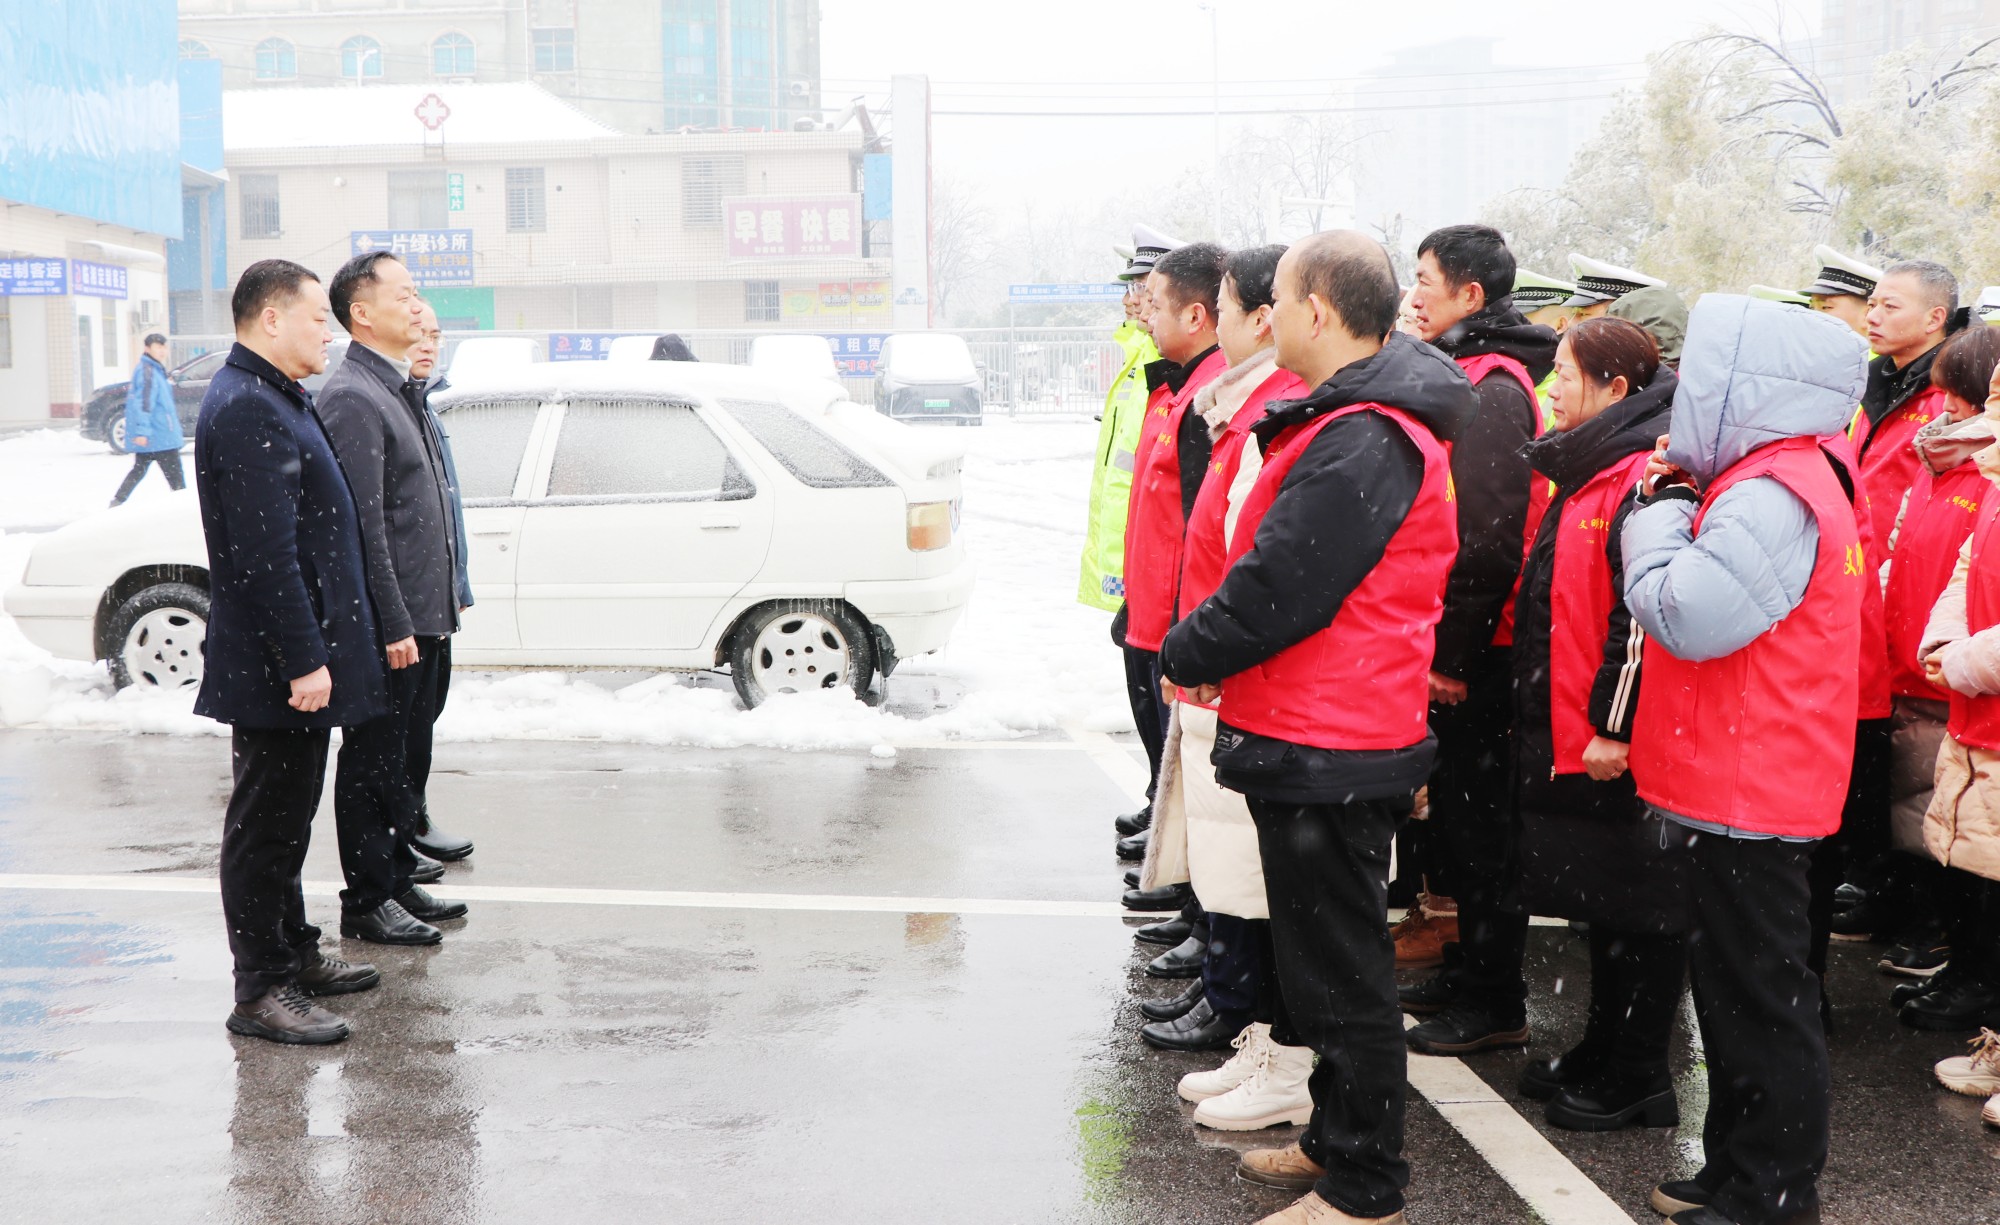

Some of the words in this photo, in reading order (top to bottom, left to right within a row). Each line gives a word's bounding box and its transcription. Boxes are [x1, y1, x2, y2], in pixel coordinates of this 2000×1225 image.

[734, 209, 784, 244] 早餐
[800, 207, 850, 242] 快餐
[373, 233, 467, 254] 一片绿诊所
